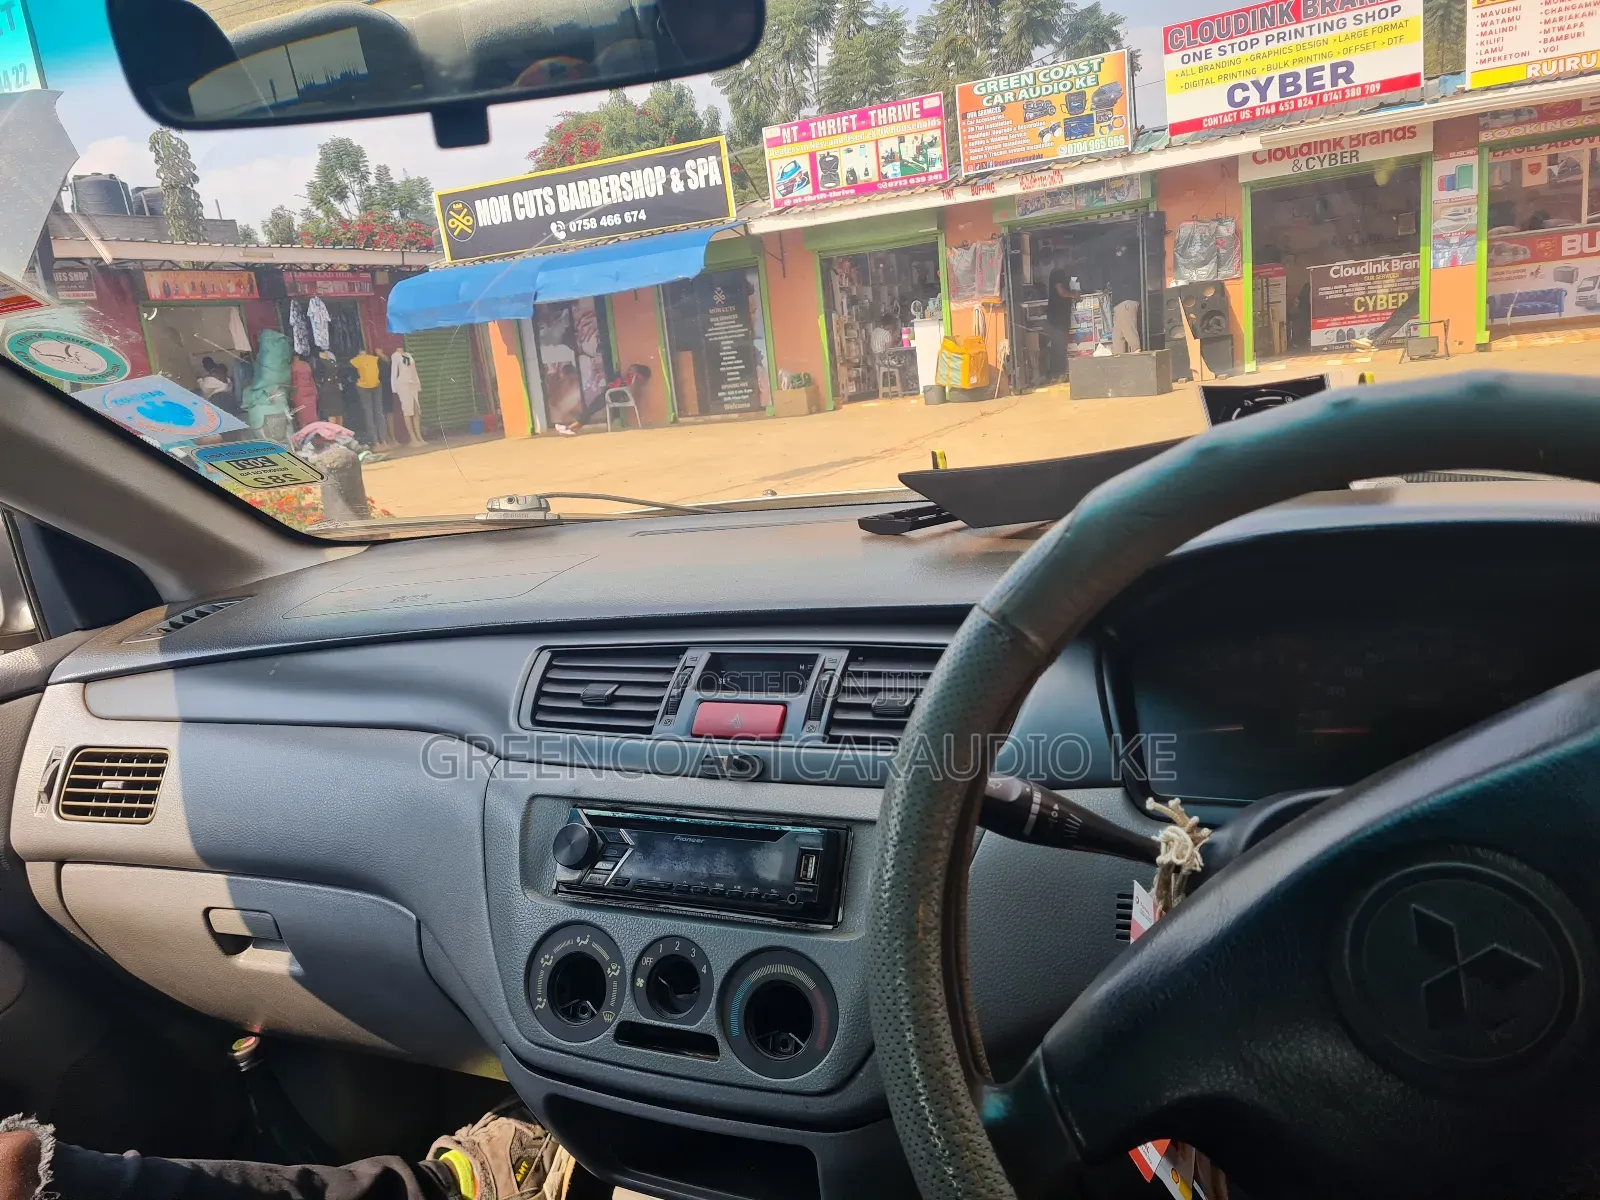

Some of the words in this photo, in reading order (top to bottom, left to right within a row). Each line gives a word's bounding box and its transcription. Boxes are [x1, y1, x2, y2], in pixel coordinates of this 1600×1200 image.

[1480, 4, 1522, 19] MAVUENI
[1480, 15, 1521, 28] WATAMU
[1544, 10, 1598, 25] MARIAKANI
[1168, 0, 1295, 49] CLOUDINK
[1181, 47, 1213, 65] ONE
[1218, 37, 1260, 57] STOP
[1265, 18, 1347, 46] PRINTING
[1353, 5, 1402, 26] SHOP
[1480, 25, 1518, 37] MALINDI
[1543, 22, 1585, 35] MTWAPA
[1180, 67, 1196, 77] ALL
[1198, 57, 1242, 74] BRANDING
[1249, 46, 1293, 62] GRAPHICS
[1295, 37, 1329, 52] DESIGN
[1338, 30, 1369, 43] LARGE
[1371, 19, 1410, 35] FORMAT
[1480, 36, 1504, 46] KILIFI
[1543, 31, 1585, 44] BAMBURI
[1480, 46, 1504, 56] LAMU
[1480, 50, 1530, 65] MPEKETONI
[1543, 45, 1559, 54] VOI
[1184, 76, 1215, 90] DIGITAL
[1217, 68, 1257, 83] PRINTING
[1266, 59, 1289, 72] BULK
[1292, 50, 1334, 67] PRINTING
[1342, 41, 1377, 55] OFFSET
[1387, 35, 1405, 46] DTF
[1526, 53, 1597, 79] RUIRU
[973, 71, 1036, 96] GREEN
[1038, 57, 1105, 82] COAST
[1227, 59, 1355, 109] CYBER
[982, 93, 1015, 107] CAR
[1017, 80, 1075, 101] AUDIO
[1075, 73, 1099, 88] KE
[1203, 111, 1238, 128] CONTACT
[1240, 108, 1254, 120] US:
[1279, 100, 1295, 112] 453
[1323, 89, 1344, 103] 0741
[1345, 85, 1362, 98] 380
[1364, 82, 1381, 94] 709
[781, 126, 799, 144] NT
[809, 114, 858, 139] THRIFT
[868, 101, 921, 128] THRIVE
[1481, 117, 1578, 141] BOOKING
[769, 146, 800, 157] Dealers
[810, 139, 827, 150] New
[828, 136, 844, 147] and
[845, 132, 864, 143] Used
[891, 117, 942, 135] Households
[1108, 134, 1125, 147] 666
[1292, 158, 1303, 173] &
[1305, 149, 1360, 171] CYBER
[474, 194, 511, 228] MOH
[513, 187, 556, 219] CUTS
[557, 165, 668, 212] BARBERSHOP
[670, 167, 684, 193] &
[685, 156, 722, 188] SPA
[569, 219, 597, 232] 0758
[600, 214, 622, 227] 466
[624, 209, 647, 223] 674
[673, 835, 705, 844] Pioneer
[675, 940, 680, 951] 2
[690, 948, 696, 957] 3
[641, 956, 654, 967] OFF
[701, 964, 707, 975] 4
